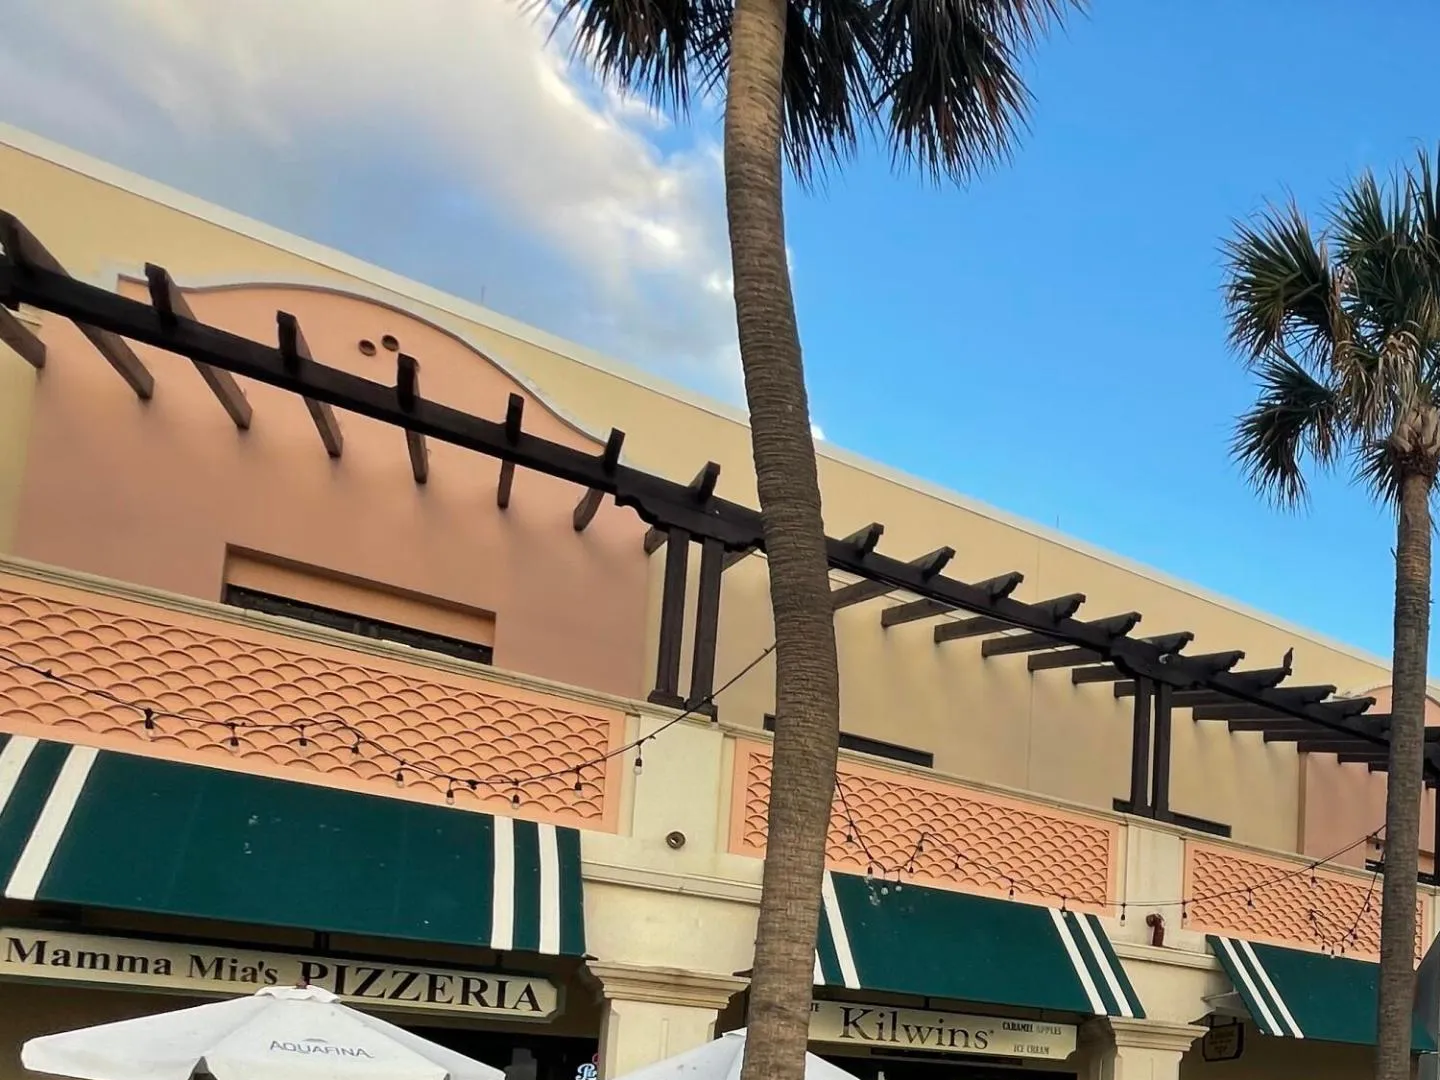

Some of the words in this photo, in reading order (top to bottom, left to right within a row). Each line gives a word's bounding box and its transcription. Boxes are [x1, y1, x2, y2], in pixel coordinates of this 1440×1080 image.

[5, 937, 173, 976] Mamma
[188, 954, 279, 985] Mia's
[298, 961, 542, 1012] PIZZERIA
[269, 1040, 374, 1059] AQUAFINA
[839, 1006, 989, 1050] Kilwins
